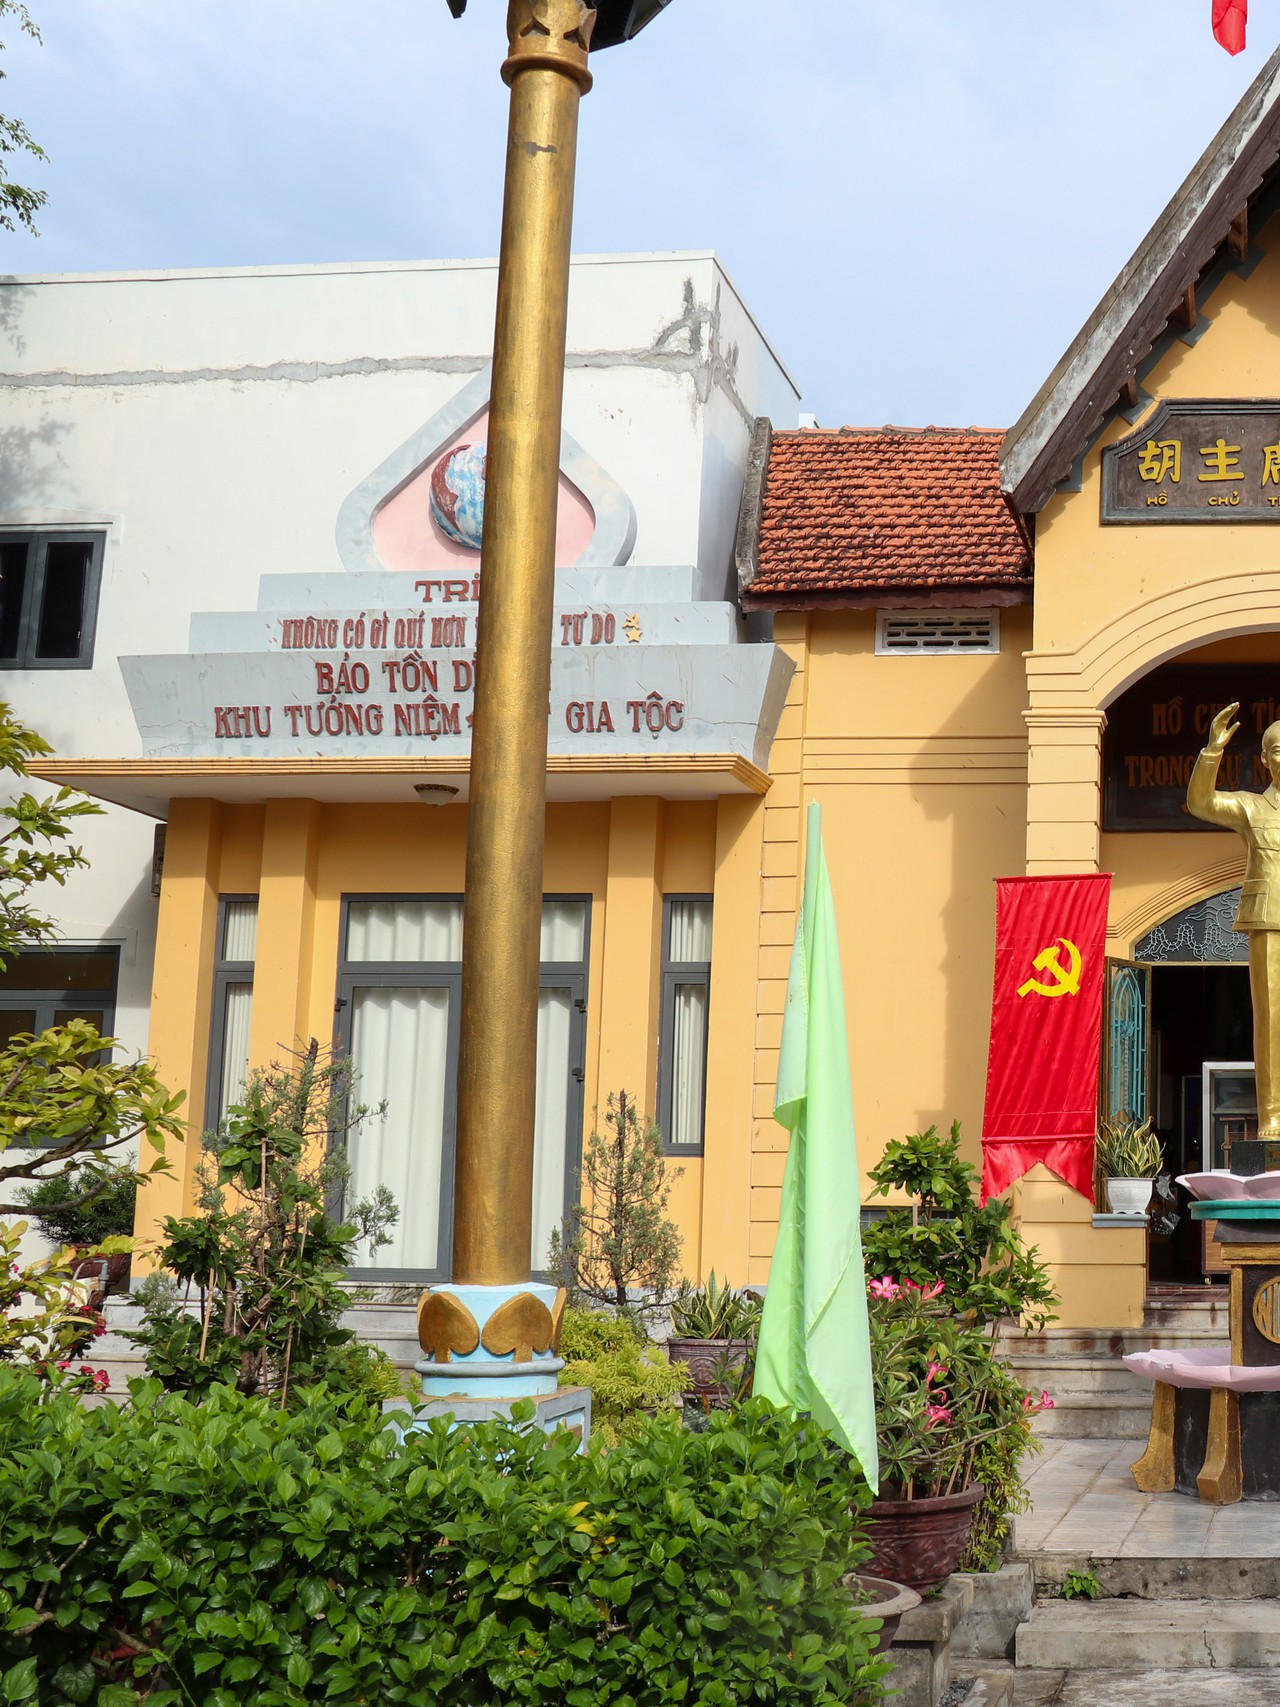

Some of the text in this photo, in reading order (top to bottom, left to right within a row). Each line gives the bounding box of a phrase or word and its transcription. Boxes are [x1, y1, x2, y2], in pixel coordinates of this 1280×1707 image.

[1146, 490, 1169, 506] HỒ
[1207, 490, 1240, 506] CHỦ
[281, 615, 339, 649] KHÔNG
[343, 611, 366, 649] CÓ
[370, 610, 389, 649] GÌ
[394, 610, 426, 648] QUÍ
[430, 614, 467, 648] HƠN
[590, 612, 616, 645] DO
[381, 649, 438, 693] TỒN
[214, 705, 272, 738] KHU
[393, 693, 461, 742] NIỆM
[565, 690, 685, 740] GIA TỘC
[1152, 694, 1185, 736] HỒ
